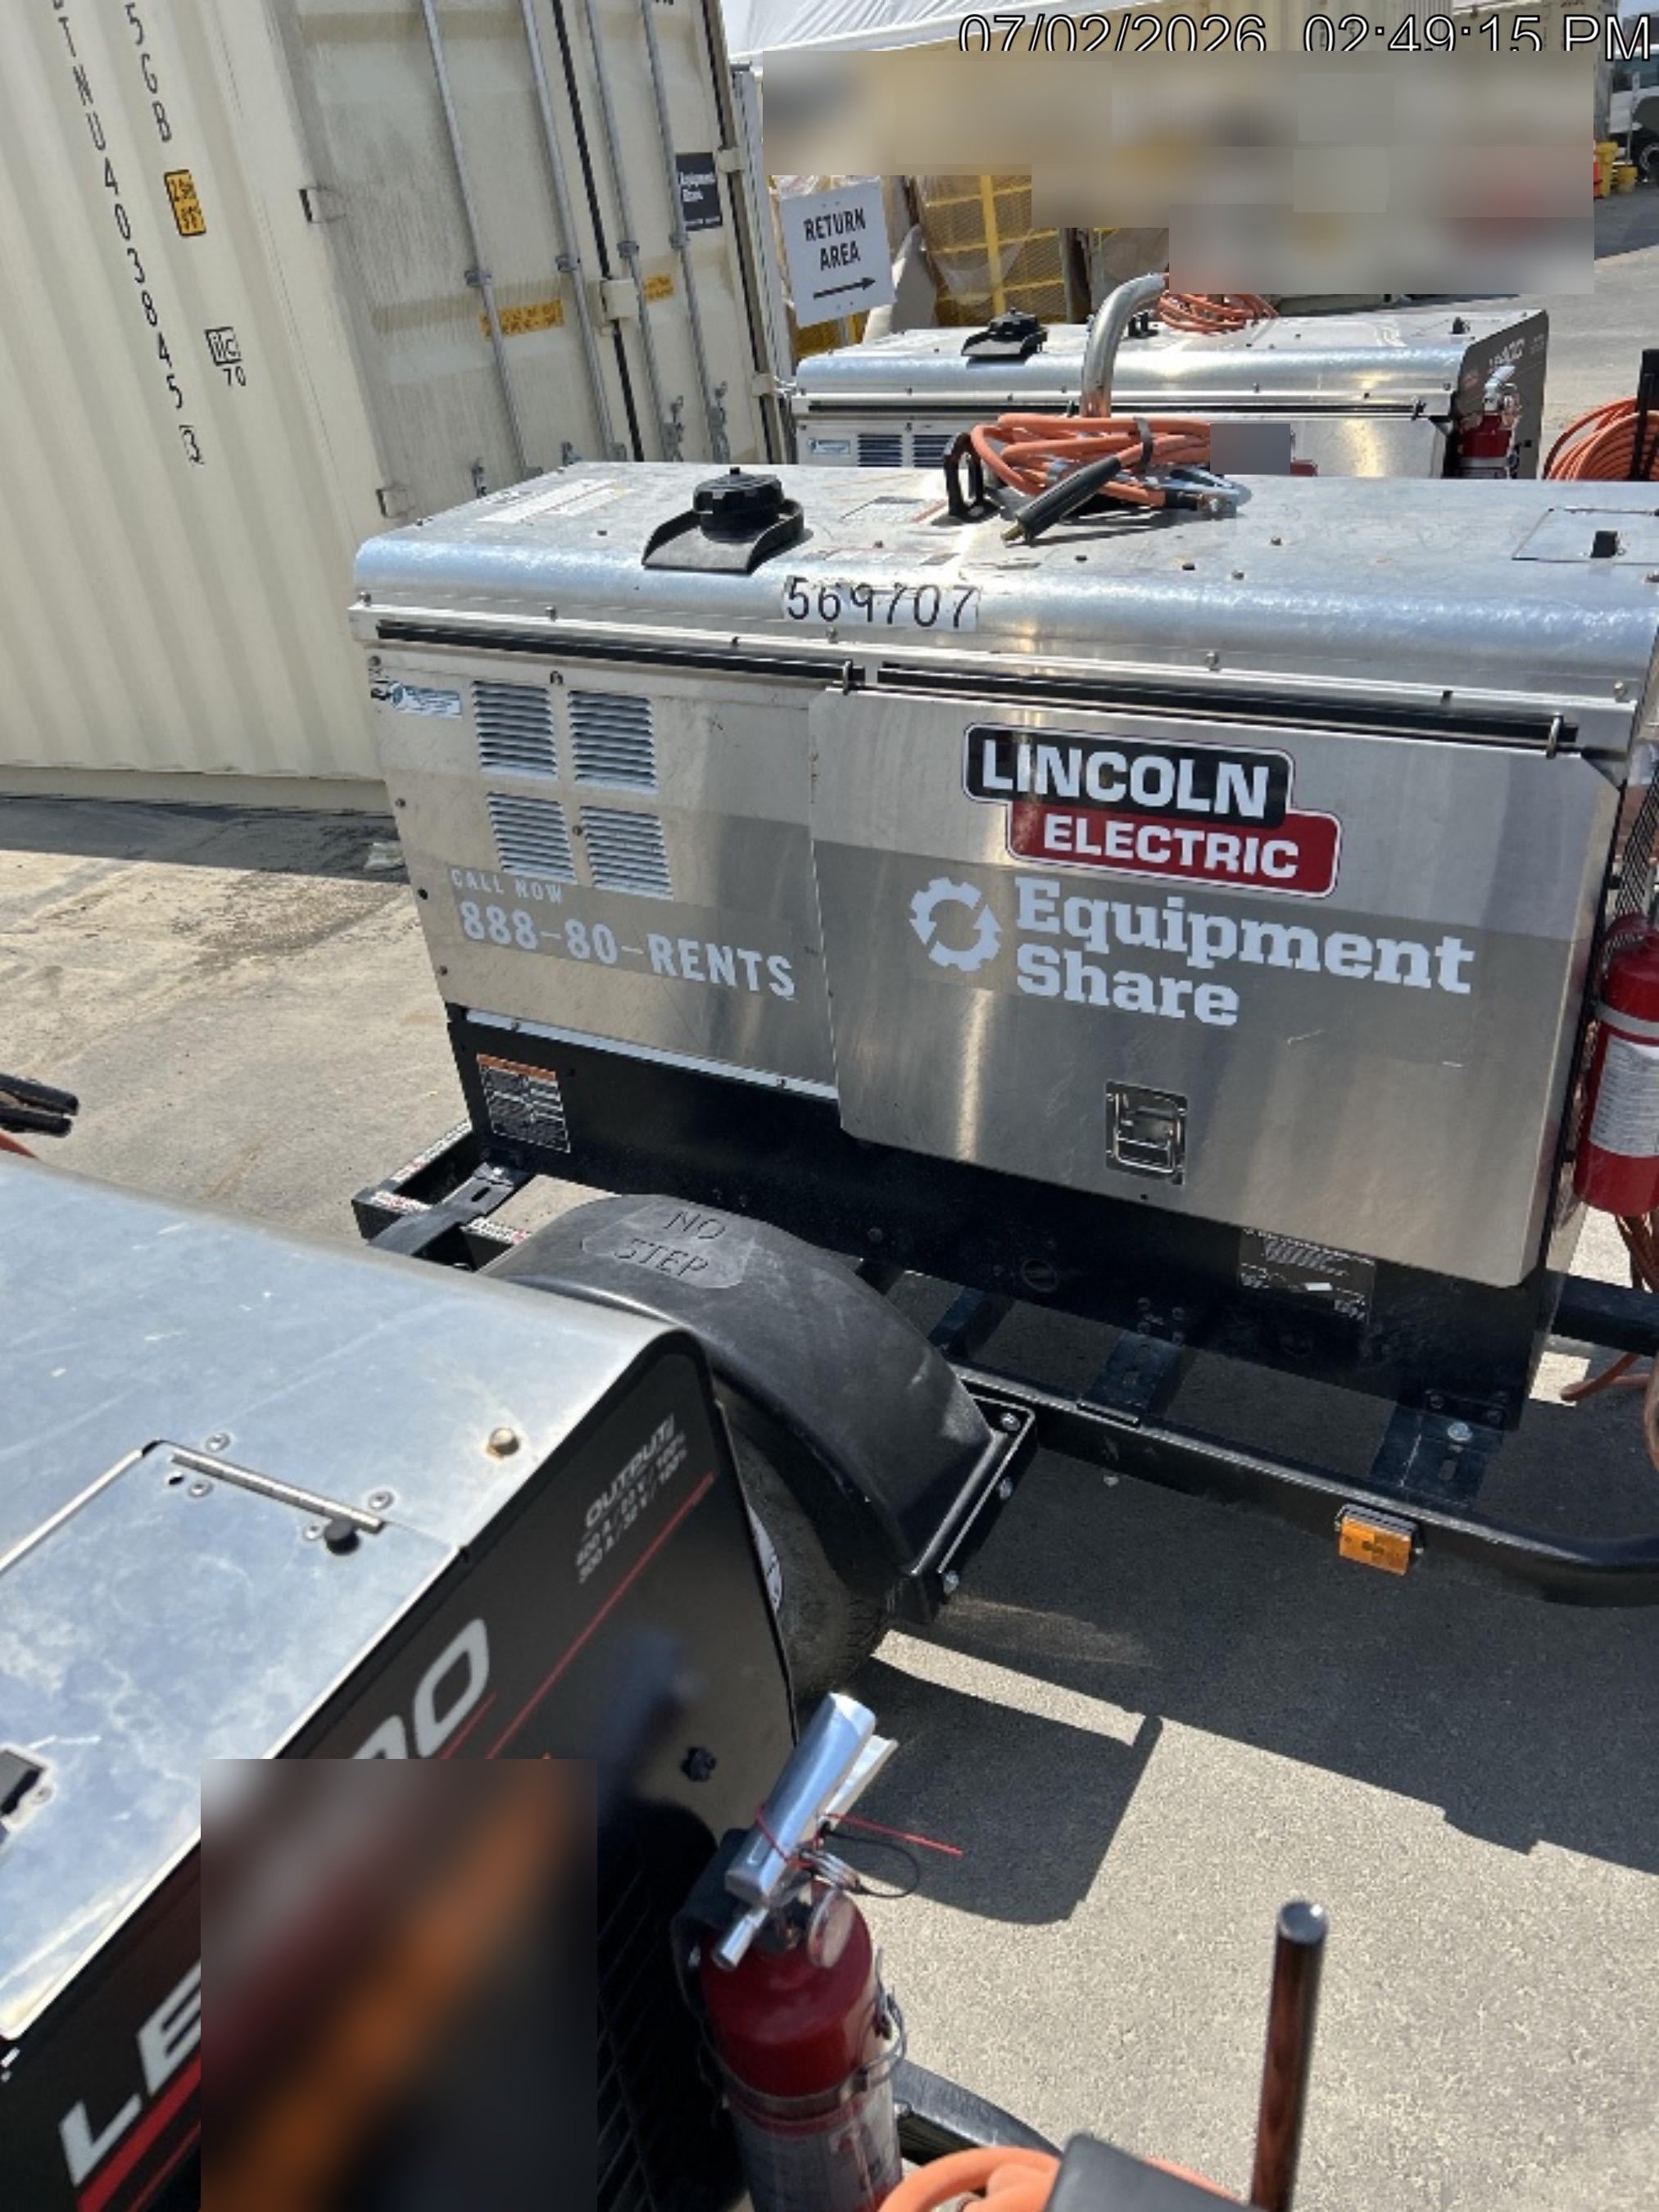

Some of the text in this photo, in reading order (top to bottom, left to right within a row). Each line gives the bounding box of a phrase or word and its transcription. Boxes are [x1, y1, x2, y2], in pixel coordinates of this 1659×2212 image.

[803, 206, 866, 242] RETURN
[820, 240, 860, 271] AREA
[787, 574, 977, 629] 569707
[982, 739, 1269, 818] LINCOLN
[1044, 814, 1299, 878] ELECTRIC
[451, 868, 564, 904] CALL NOW
[460, 902, 796, 999] 888-80-RENTS
[1015, 876, 1475, 995] Equipment
[1017, 942, 1240, 1027] Share
[663, 1209, 727, 1240] NO
[614, 1237, 709, 1277] STEP
